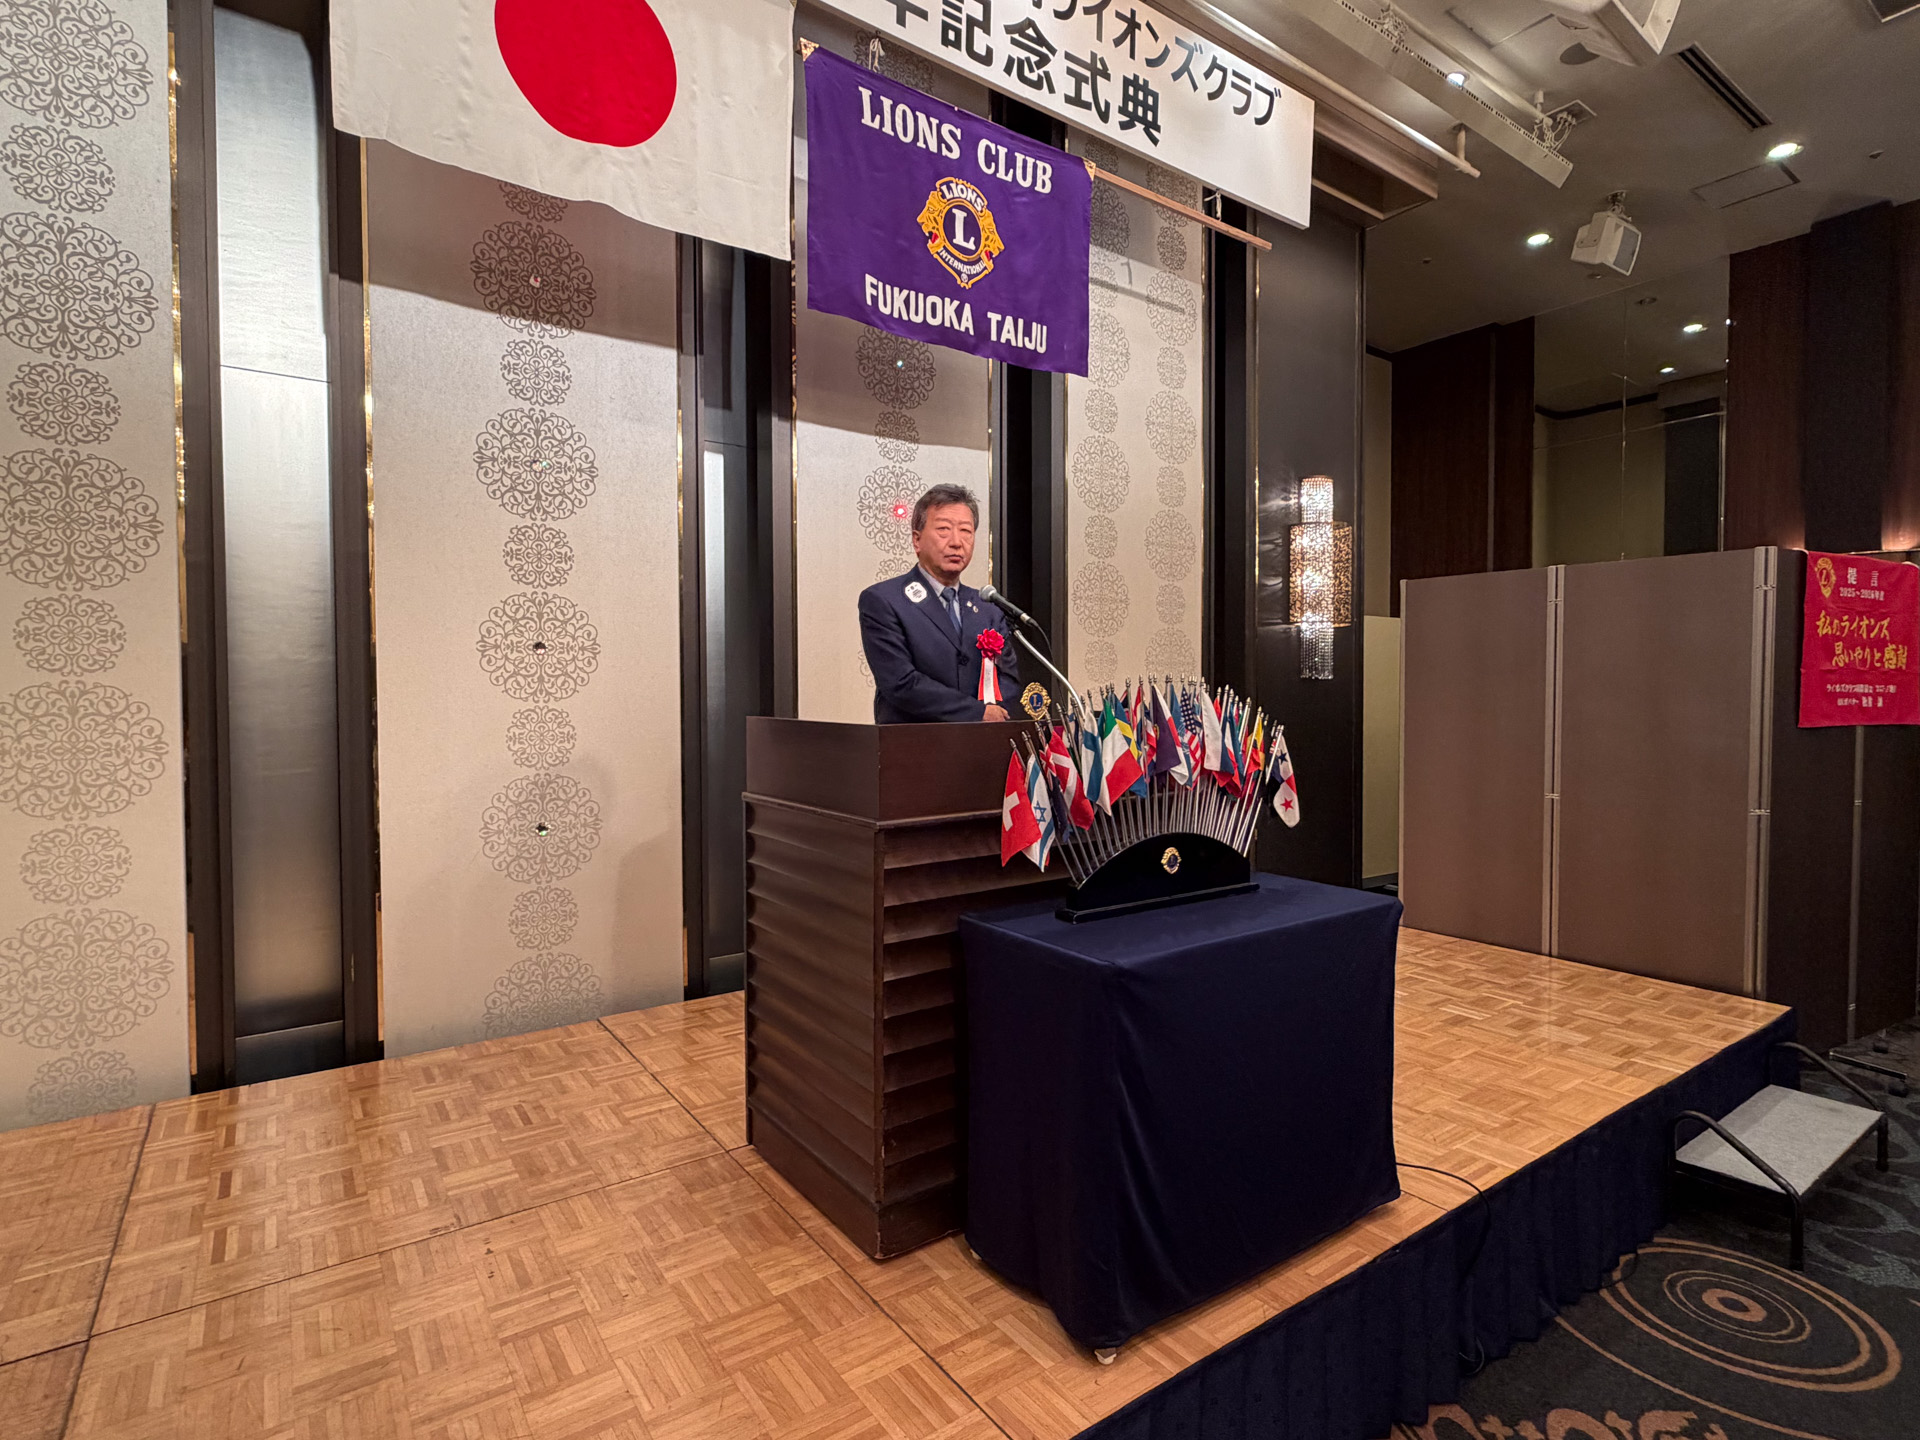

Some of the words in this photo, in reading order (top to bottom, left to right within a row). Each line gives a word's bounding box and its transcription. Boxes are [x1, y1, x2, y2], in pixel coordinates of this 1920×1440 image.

[1031, 0, 1281, 126] イオンズクラブ
[858, 86, 961, 159] LIONS
[977, 138, 1053, 194] CLUB
[940, 183, 984, 211] LIONS
[952, 208, 976, 250] L
[938, 247, 985, 275] INTERNATIONAL
[865, 273, 974, 336] FUKUOKA
[987, 311, 1047, 354] TAIJU
